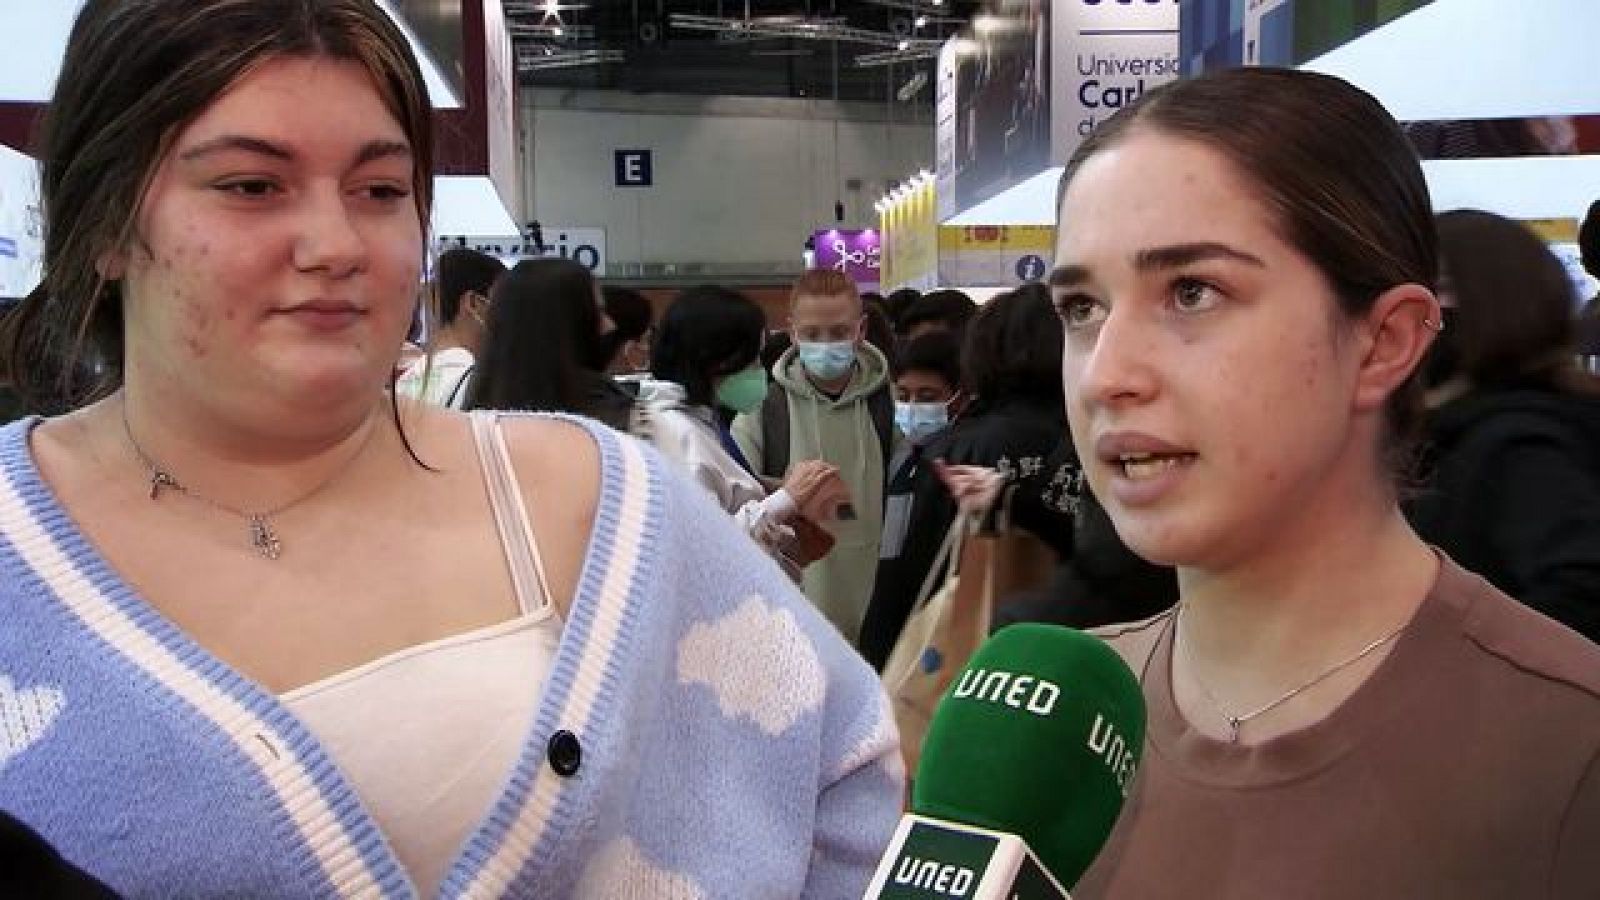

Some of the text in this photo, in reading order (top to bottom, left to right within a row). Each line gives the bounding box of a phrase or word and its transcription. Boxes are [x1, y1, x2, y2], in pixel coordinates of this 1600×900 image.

[624, 154, 642, 181] E
[955, 668, 1061, 716] UNED
[894, 855, 974, 896] UNED
